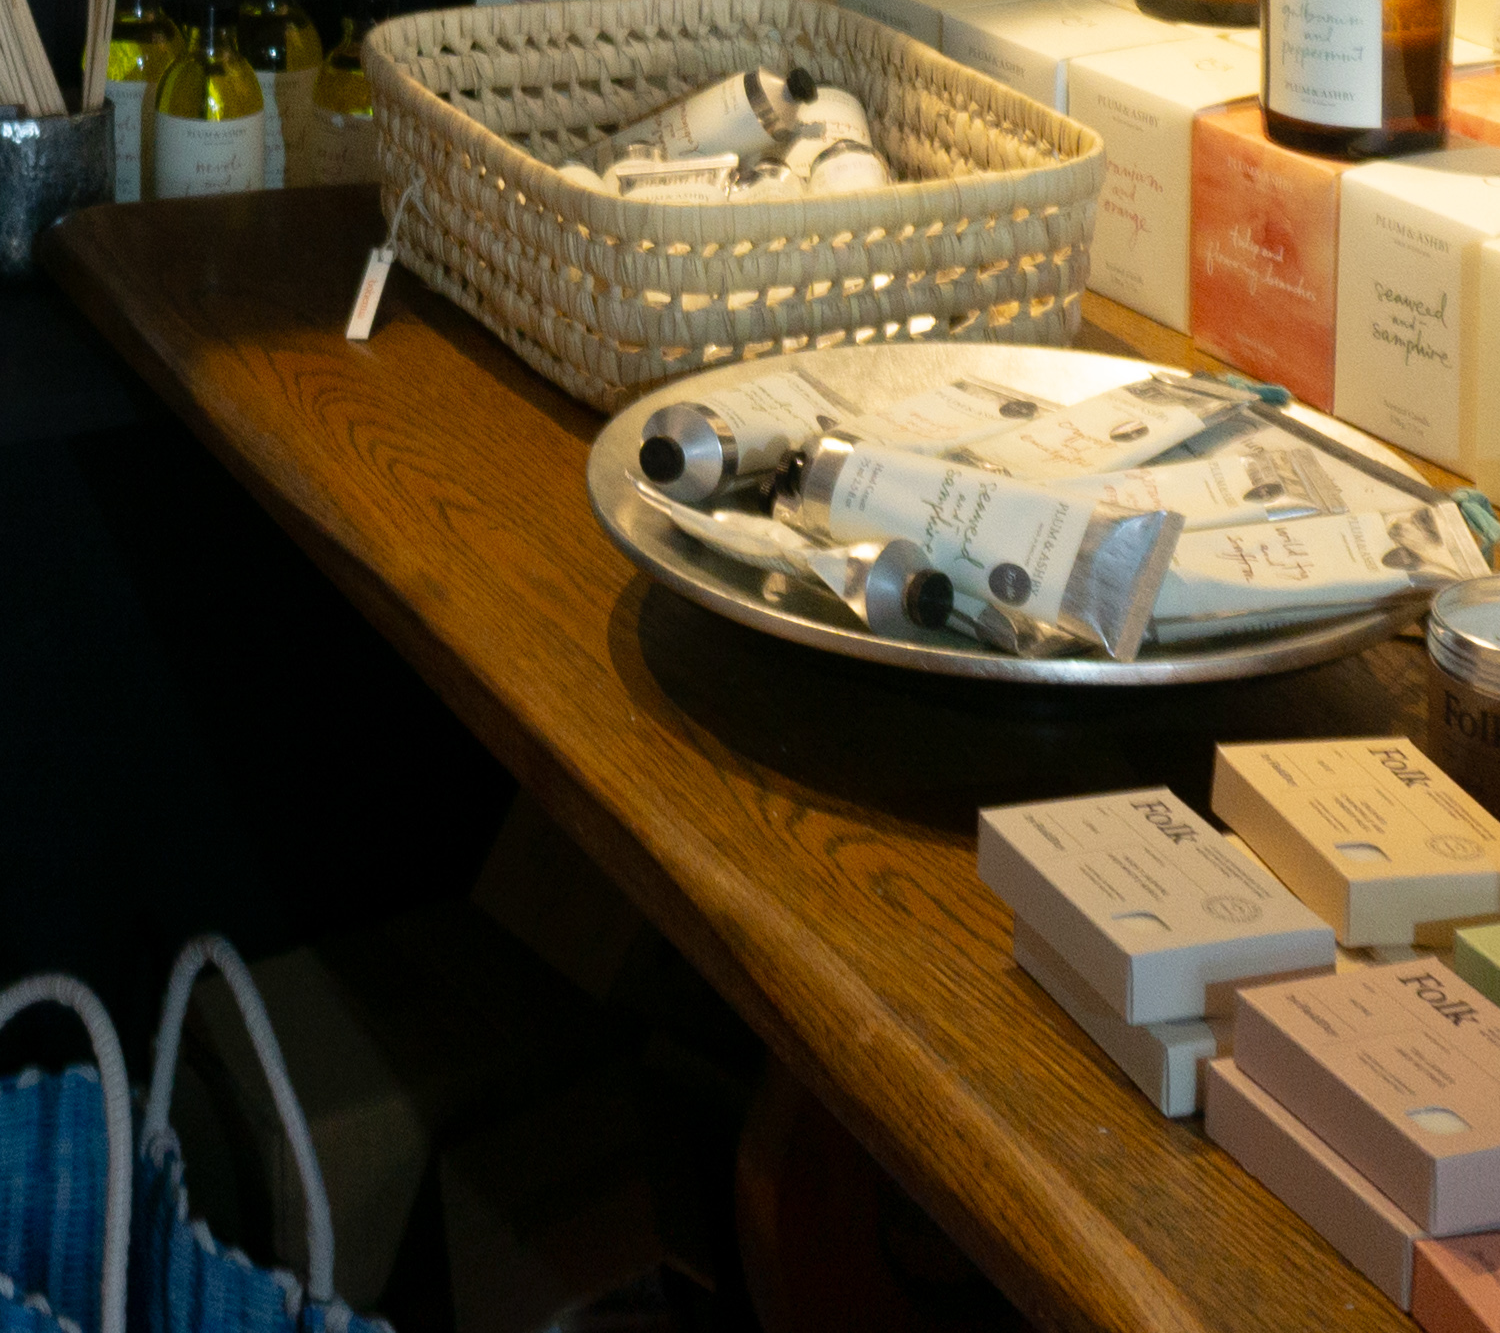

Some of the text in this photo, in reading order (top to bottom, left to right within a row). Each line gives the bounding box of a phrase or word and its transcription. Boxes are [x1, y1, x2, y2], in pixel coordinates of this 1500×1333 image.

[1375, 214, 1406, 236] PLUM
[1416, 229, 1451, 254] ASHBY
[1373, 281, 1450, 329] seaweed
[1392, 314, 1417, 332] and
[1372, 322, 1454, 370] samphire
[1367, 745, 1433, 789] Folk
[1129, 798, 1198, 846] Folk
[1396, 972, 1479, 1027] Folk
